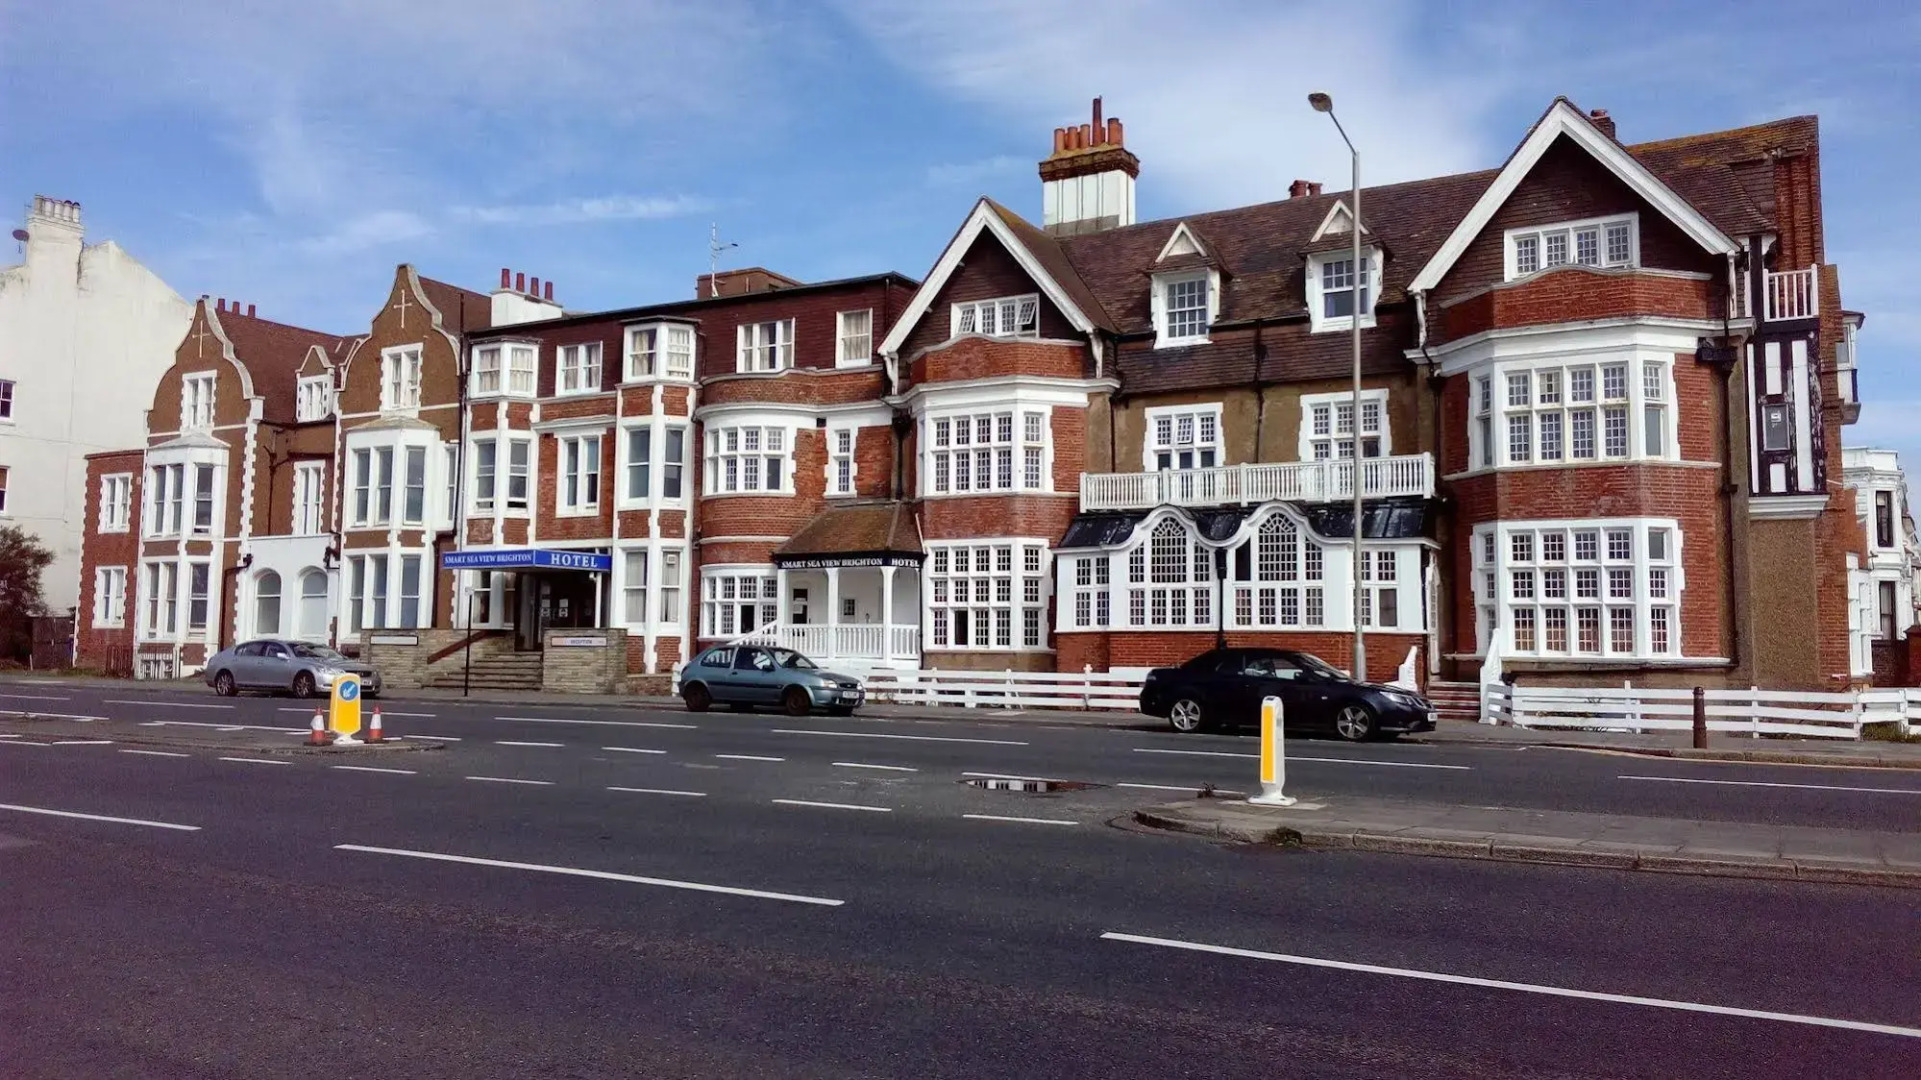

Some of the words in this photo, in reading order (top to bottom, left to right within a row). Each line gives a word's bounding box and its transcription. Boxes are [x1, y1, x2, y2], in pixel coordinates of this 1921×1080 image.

[445, 555, 466, 564] SMART
[467, 555, 479, 563] SEA
[480, 554, 496, 562] VIEW
[497, 553, 532, 562] BRIGHTON
[551, 553, 598, 568] HOTEL
[782, 560, 806, 568] SMART
[821, 559, 840, 567] VIEW
[842, 558, 882, 566] BRIGHTON
[892, 559, 920, 567] HOTEL
